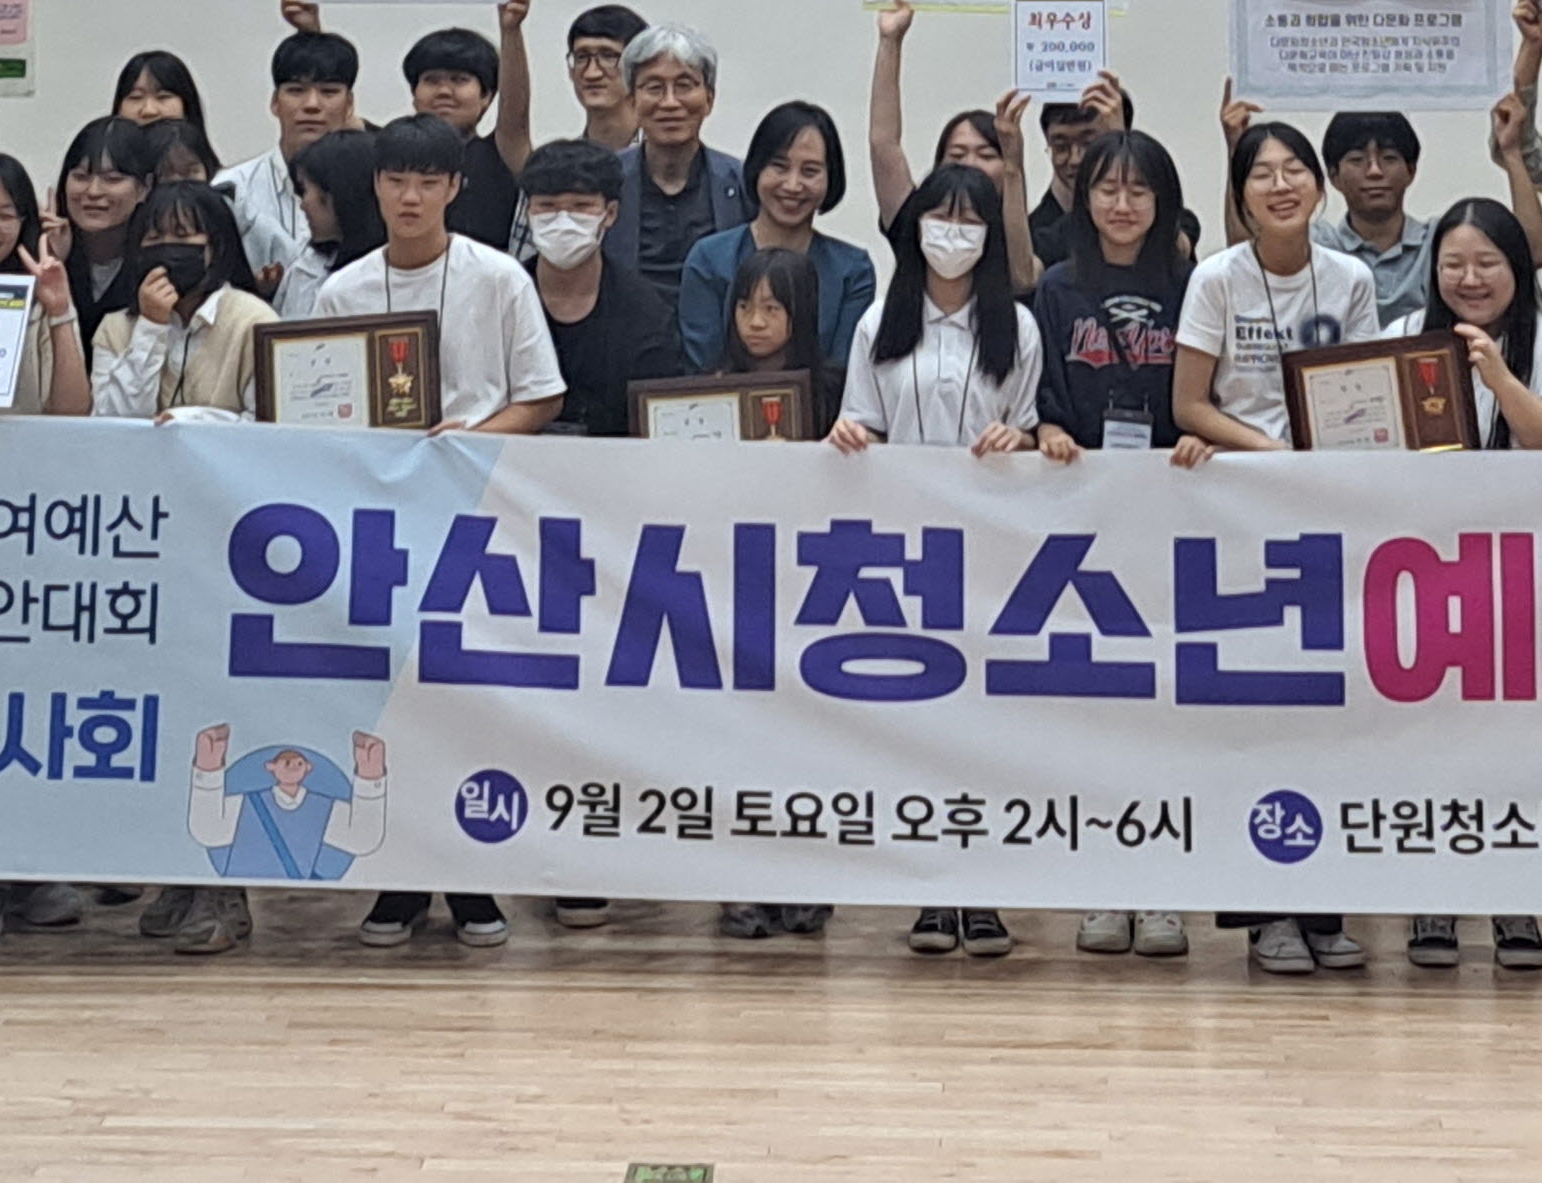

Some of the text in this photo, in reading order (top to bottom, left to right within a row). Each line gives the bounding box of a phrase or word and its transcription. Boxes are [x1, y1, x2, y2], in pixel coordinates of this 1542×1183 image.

[1028, 11, 1091, 30] 최우수상
[1414, 14, 1462, 28] 프로그램
[459, 780, 522, 831] 일시
[544, 782, 623, 838] 9월
[637, 784, 716, 841] 2일
[729, 788, 876, 845] 토요일
[891, 792, 989, 847] 오후
[1002, 795, 1194, 853] 2시~6시
[1253, 802, 1316, 849] 장소
